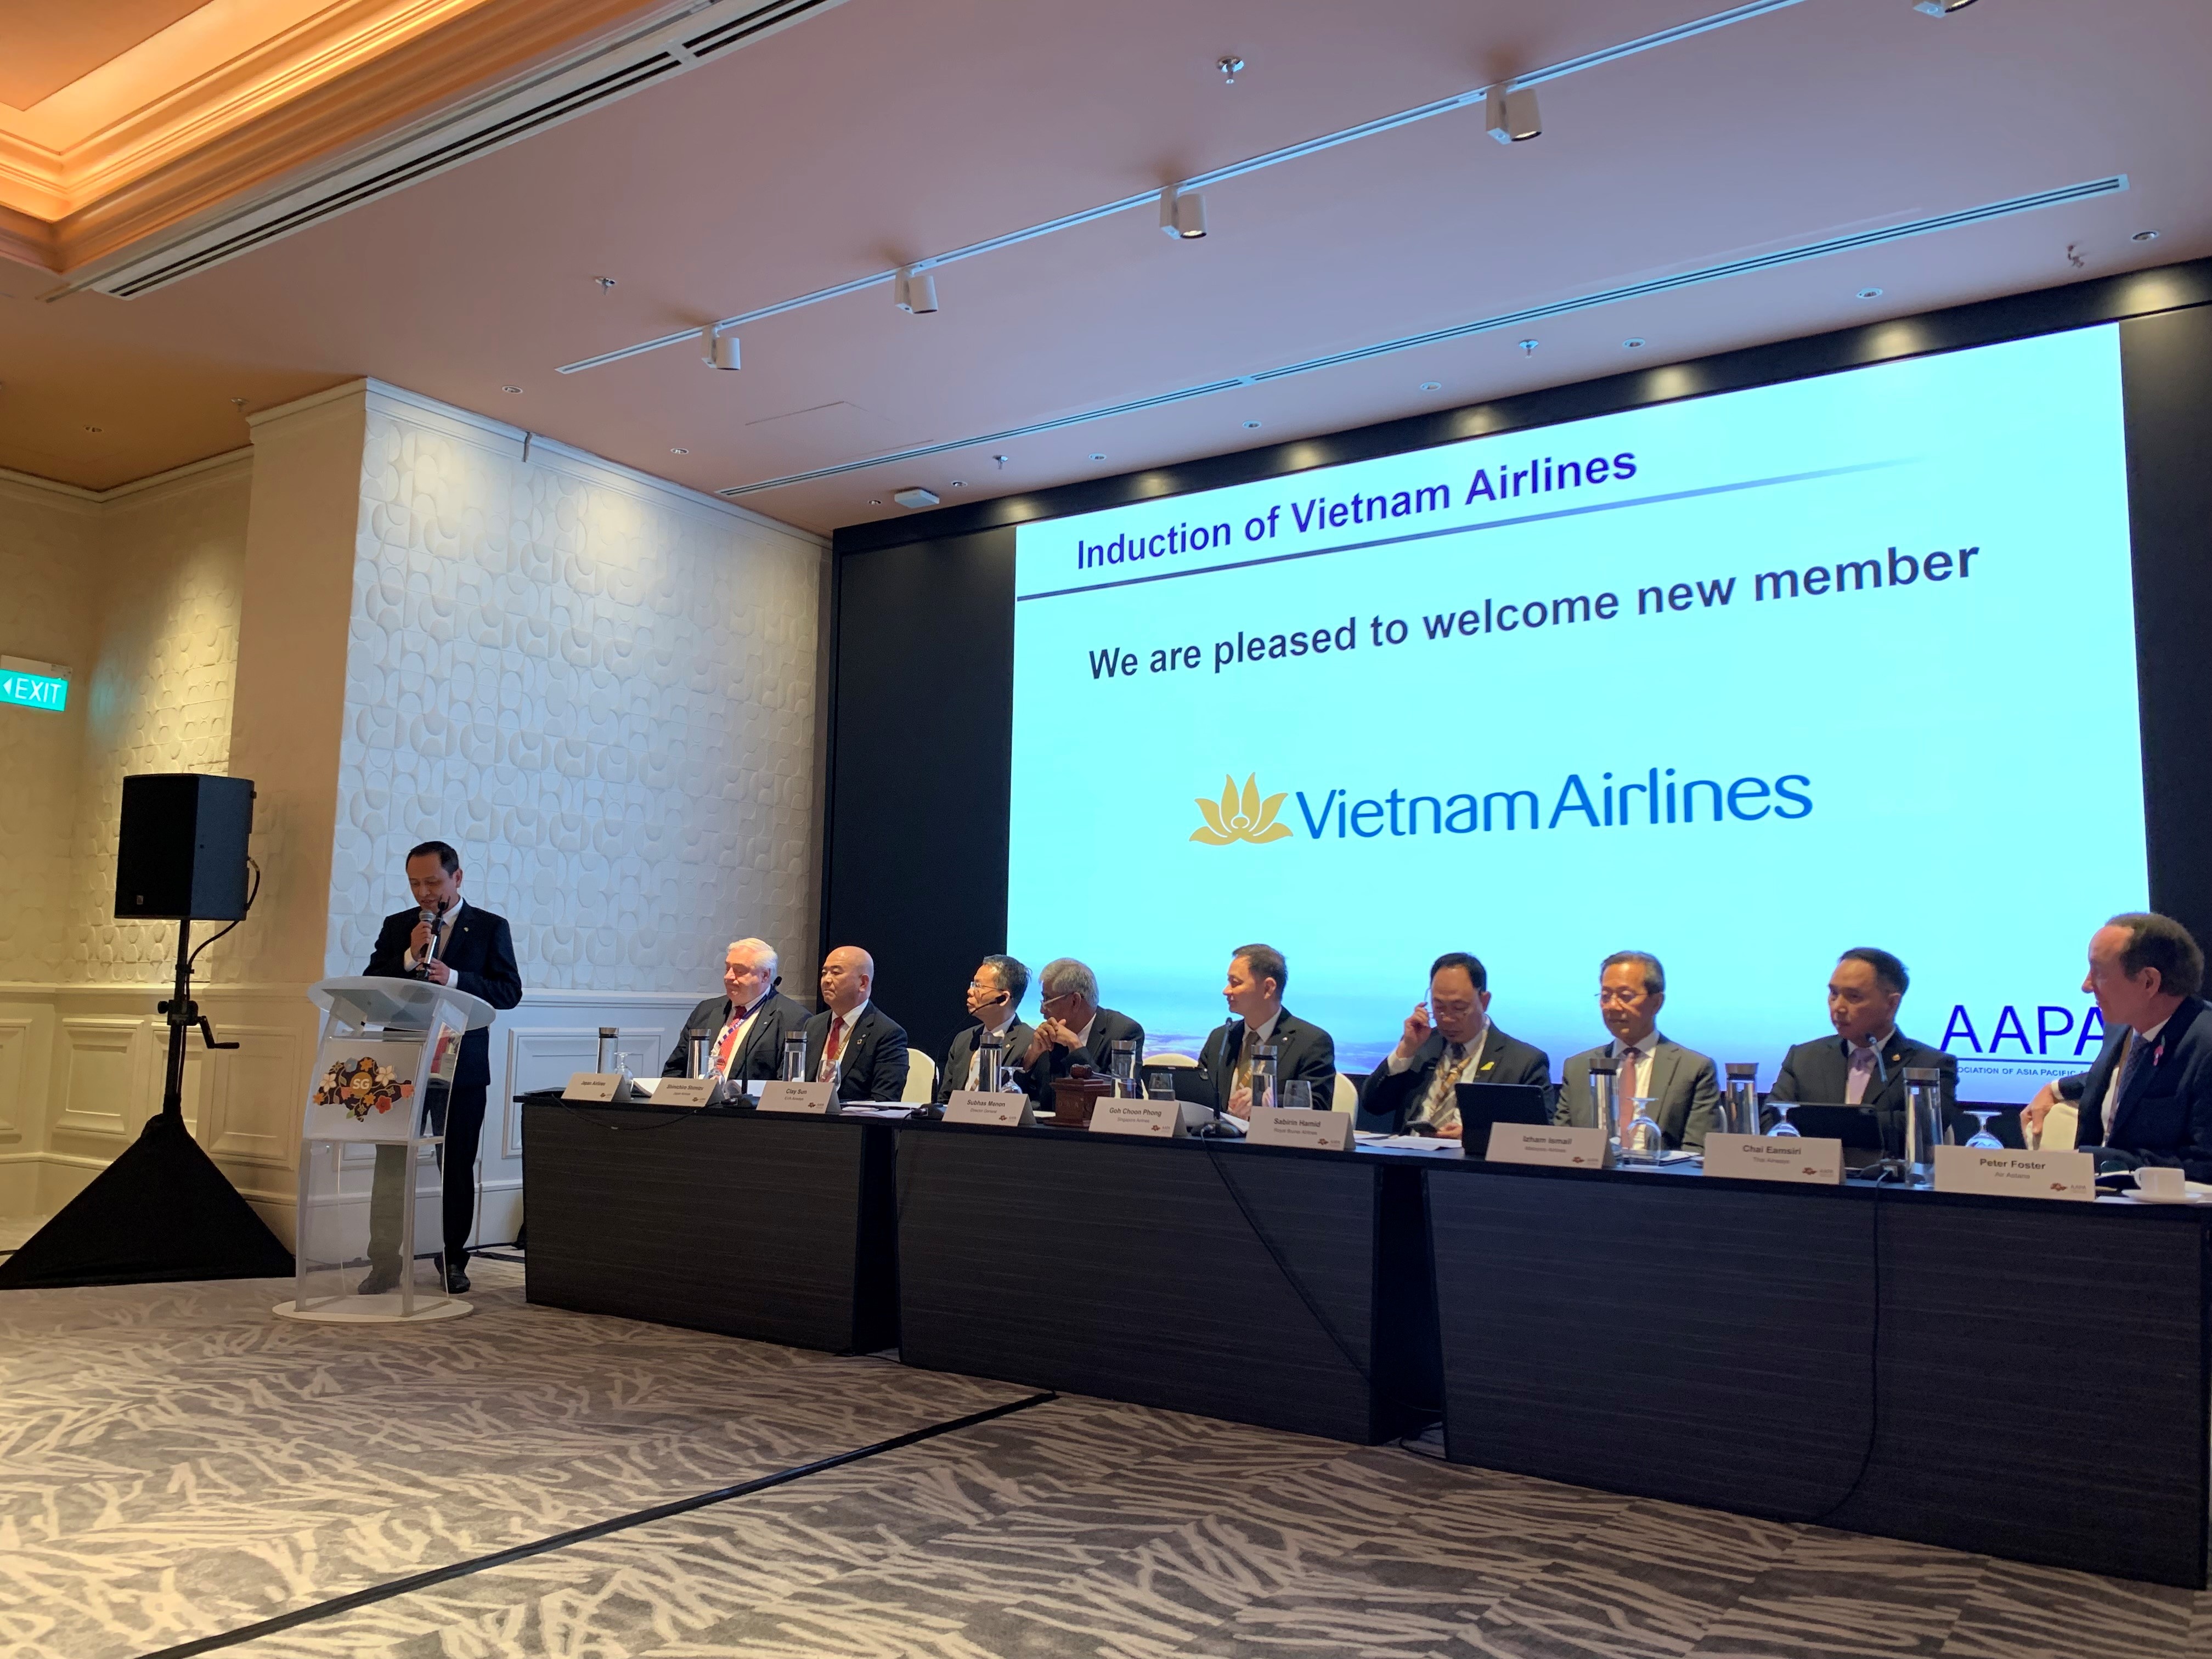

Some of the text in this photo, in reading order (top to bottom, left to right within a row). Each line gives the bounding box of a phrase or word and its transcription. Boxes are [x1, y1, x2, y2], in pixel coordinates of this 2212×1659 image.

[1079, 453, 1637, 569] Induction of Vietnam Airlines
[1089, 548, 1979, 679] We are pleased to welcome new member
[15, 678, 61, 704] EXIT
[1296, 768, 1813, 839] Vietnam Airlines
[1939, 1005, 2104, 1056] AAPA
[2040, 1069, 2076, 1077] PACIFIC
[353, 1078, 370, 1090] SG
[1143, 1108, 1162, 1117] Phong
[1273, 1118, 1297, 1126] Sabirin
[1742, 1144, 1802, 1155] Chai Eamsiri
[1979, 1158, 2046, 1170] Peter Foster
